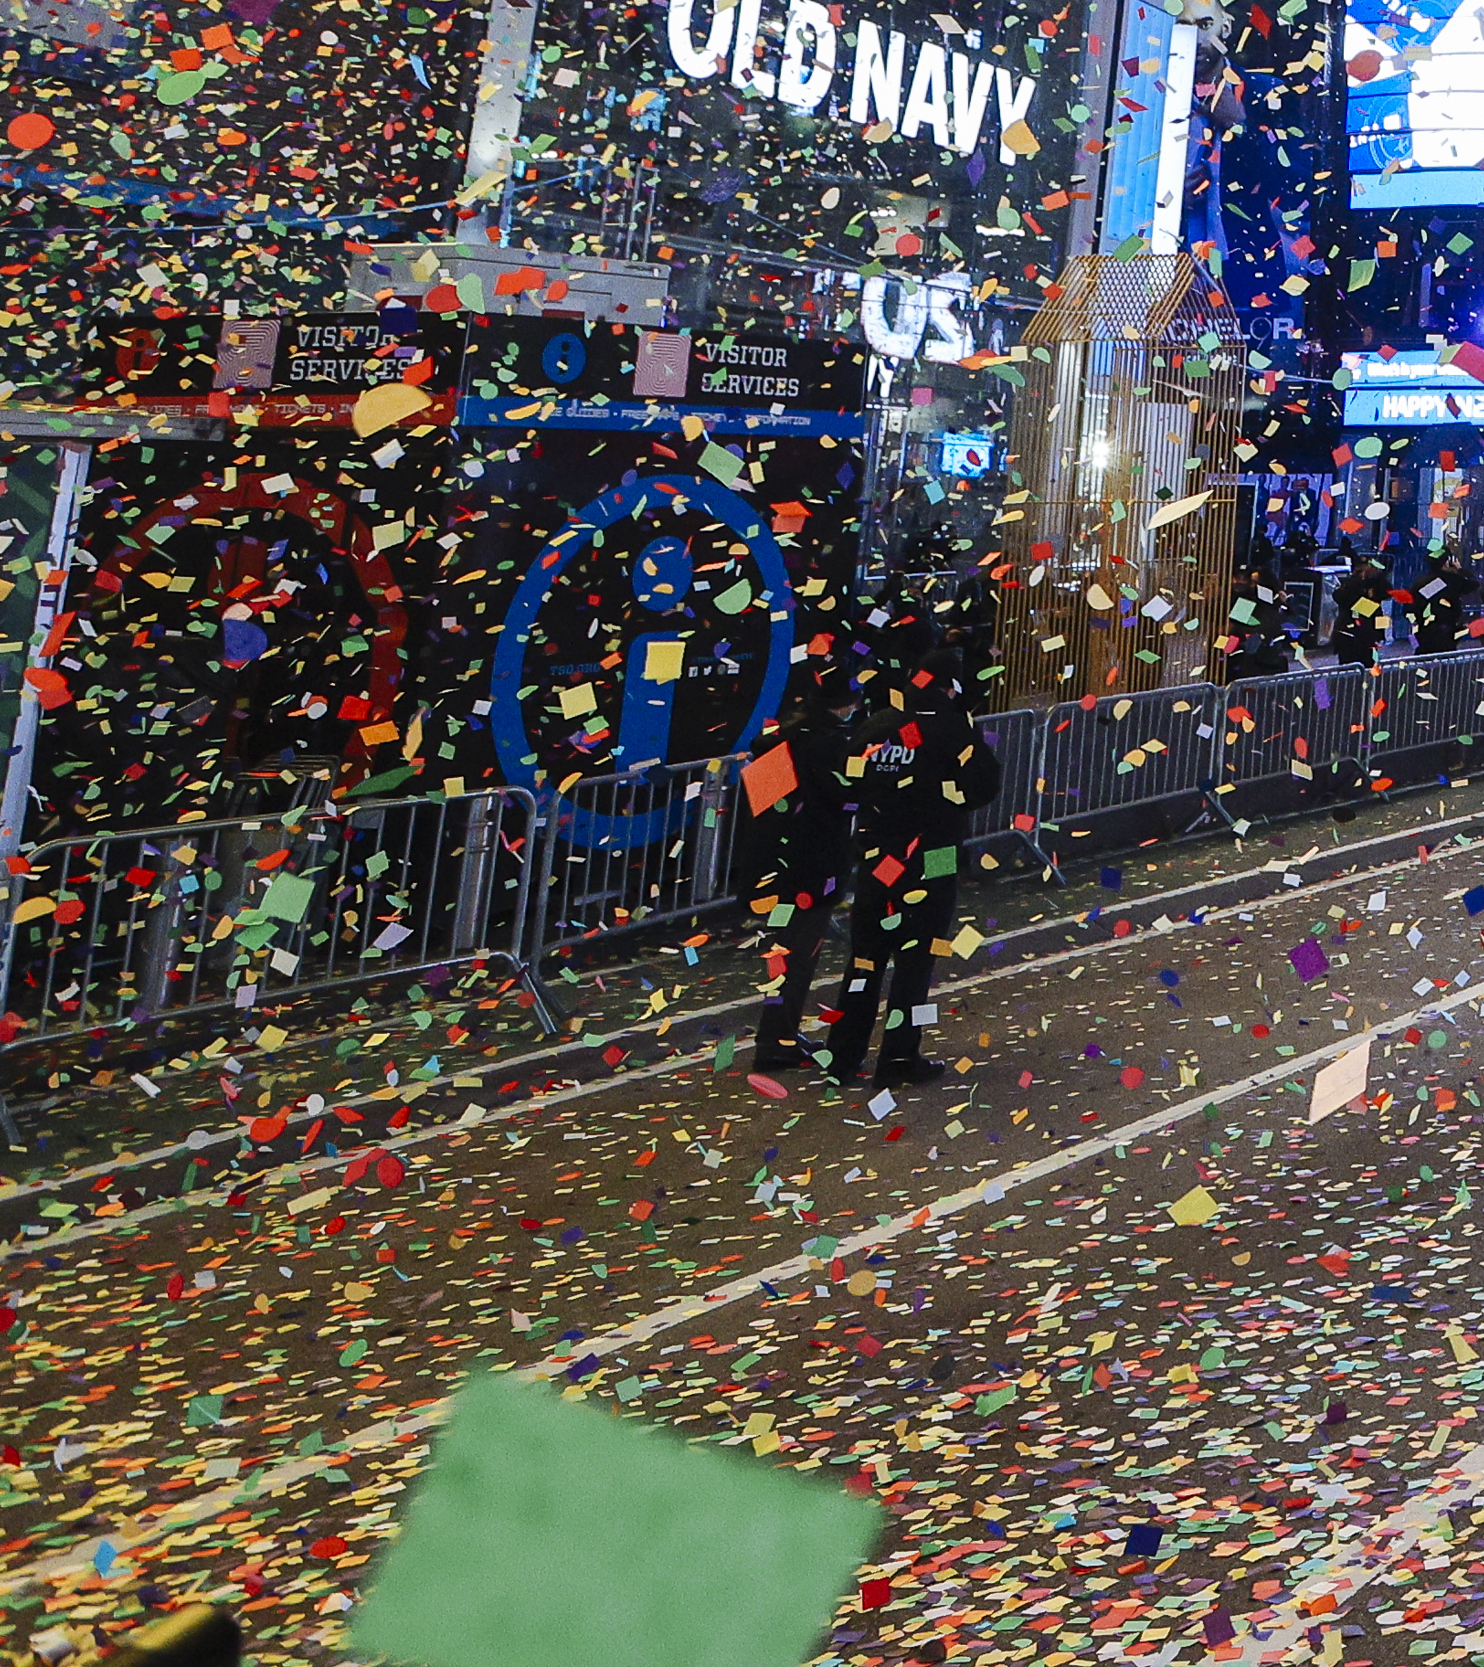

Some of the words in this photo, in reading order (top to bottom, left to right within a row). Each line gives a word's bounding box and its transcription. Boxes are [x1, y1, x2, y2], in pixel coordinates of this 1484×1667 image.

[850, 19, 1036, 166] NAVY
[705, 343, 787, 367] VISITOR
[701, 373, 799, 397] SERVICES
[1383, 395, 1447, 418] HAPPY
